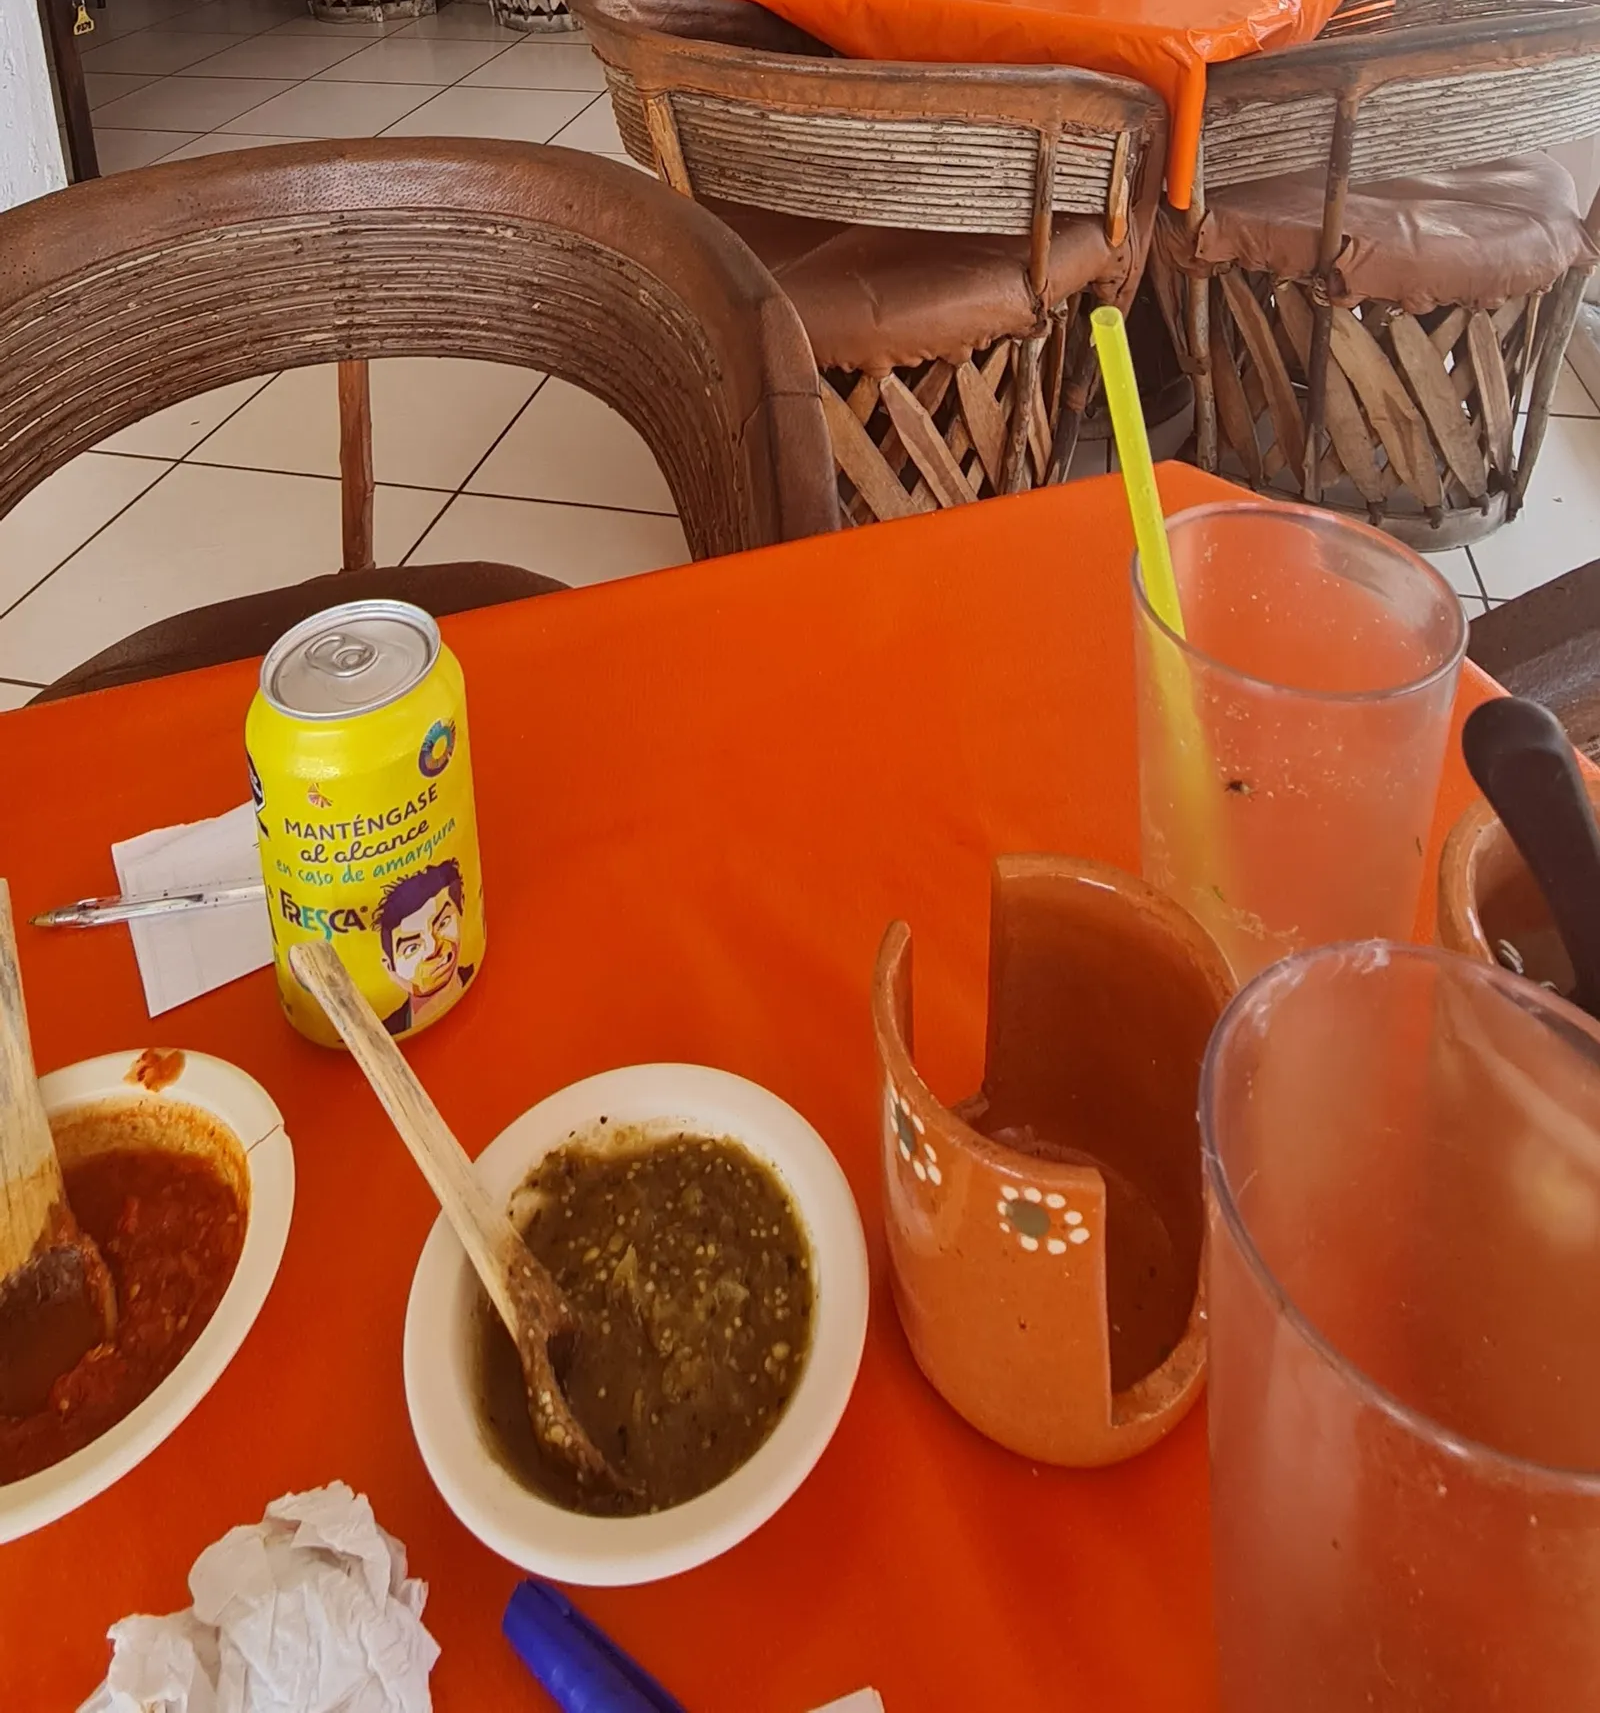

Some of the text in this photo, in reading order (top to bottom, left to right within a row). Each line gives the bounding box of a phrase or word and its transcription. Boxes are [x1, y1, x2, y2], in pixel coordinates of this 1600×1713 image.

[284, 782, 438, 841] MANTÉNGASE
[276, 817, 456, 886] en caso de amargura
[301, 819, 430, 864] al alcance
[279, 887, 367, 943] FRESCA
